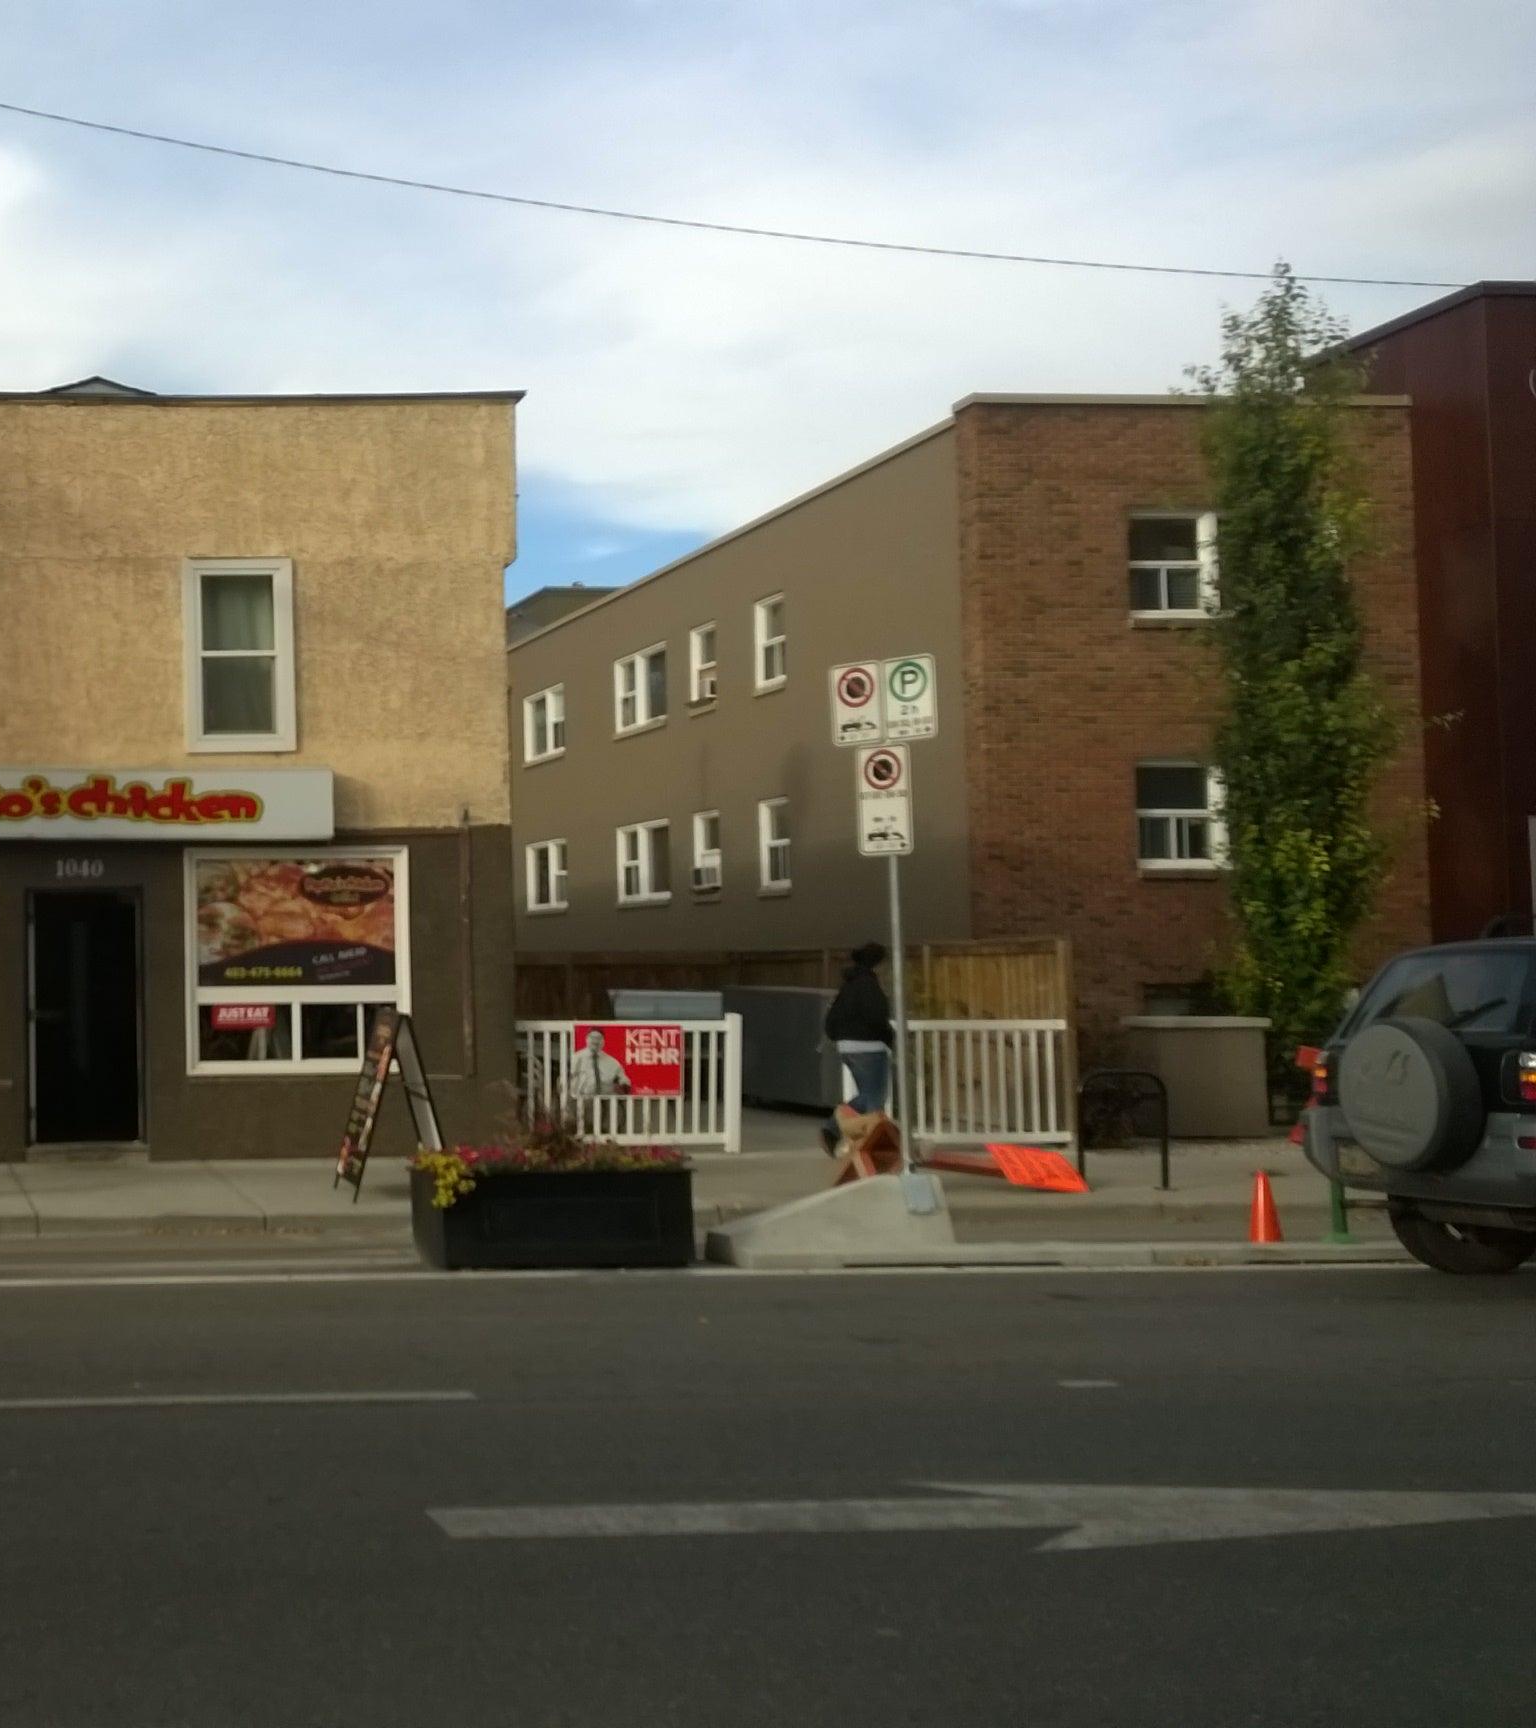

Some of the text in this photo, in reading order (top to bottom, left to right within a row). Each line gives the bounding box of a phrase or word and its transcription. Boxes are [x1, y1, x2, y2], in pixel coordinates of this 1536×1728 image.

[67, 774, 263, 824] chicken
[56, 859, 104, 877] 1040
[218, 1007, 269, 1018] JUST EAT
[625, 1028, 680, 1047] KENT
[625, 1048, 680, 1065] HEHR
